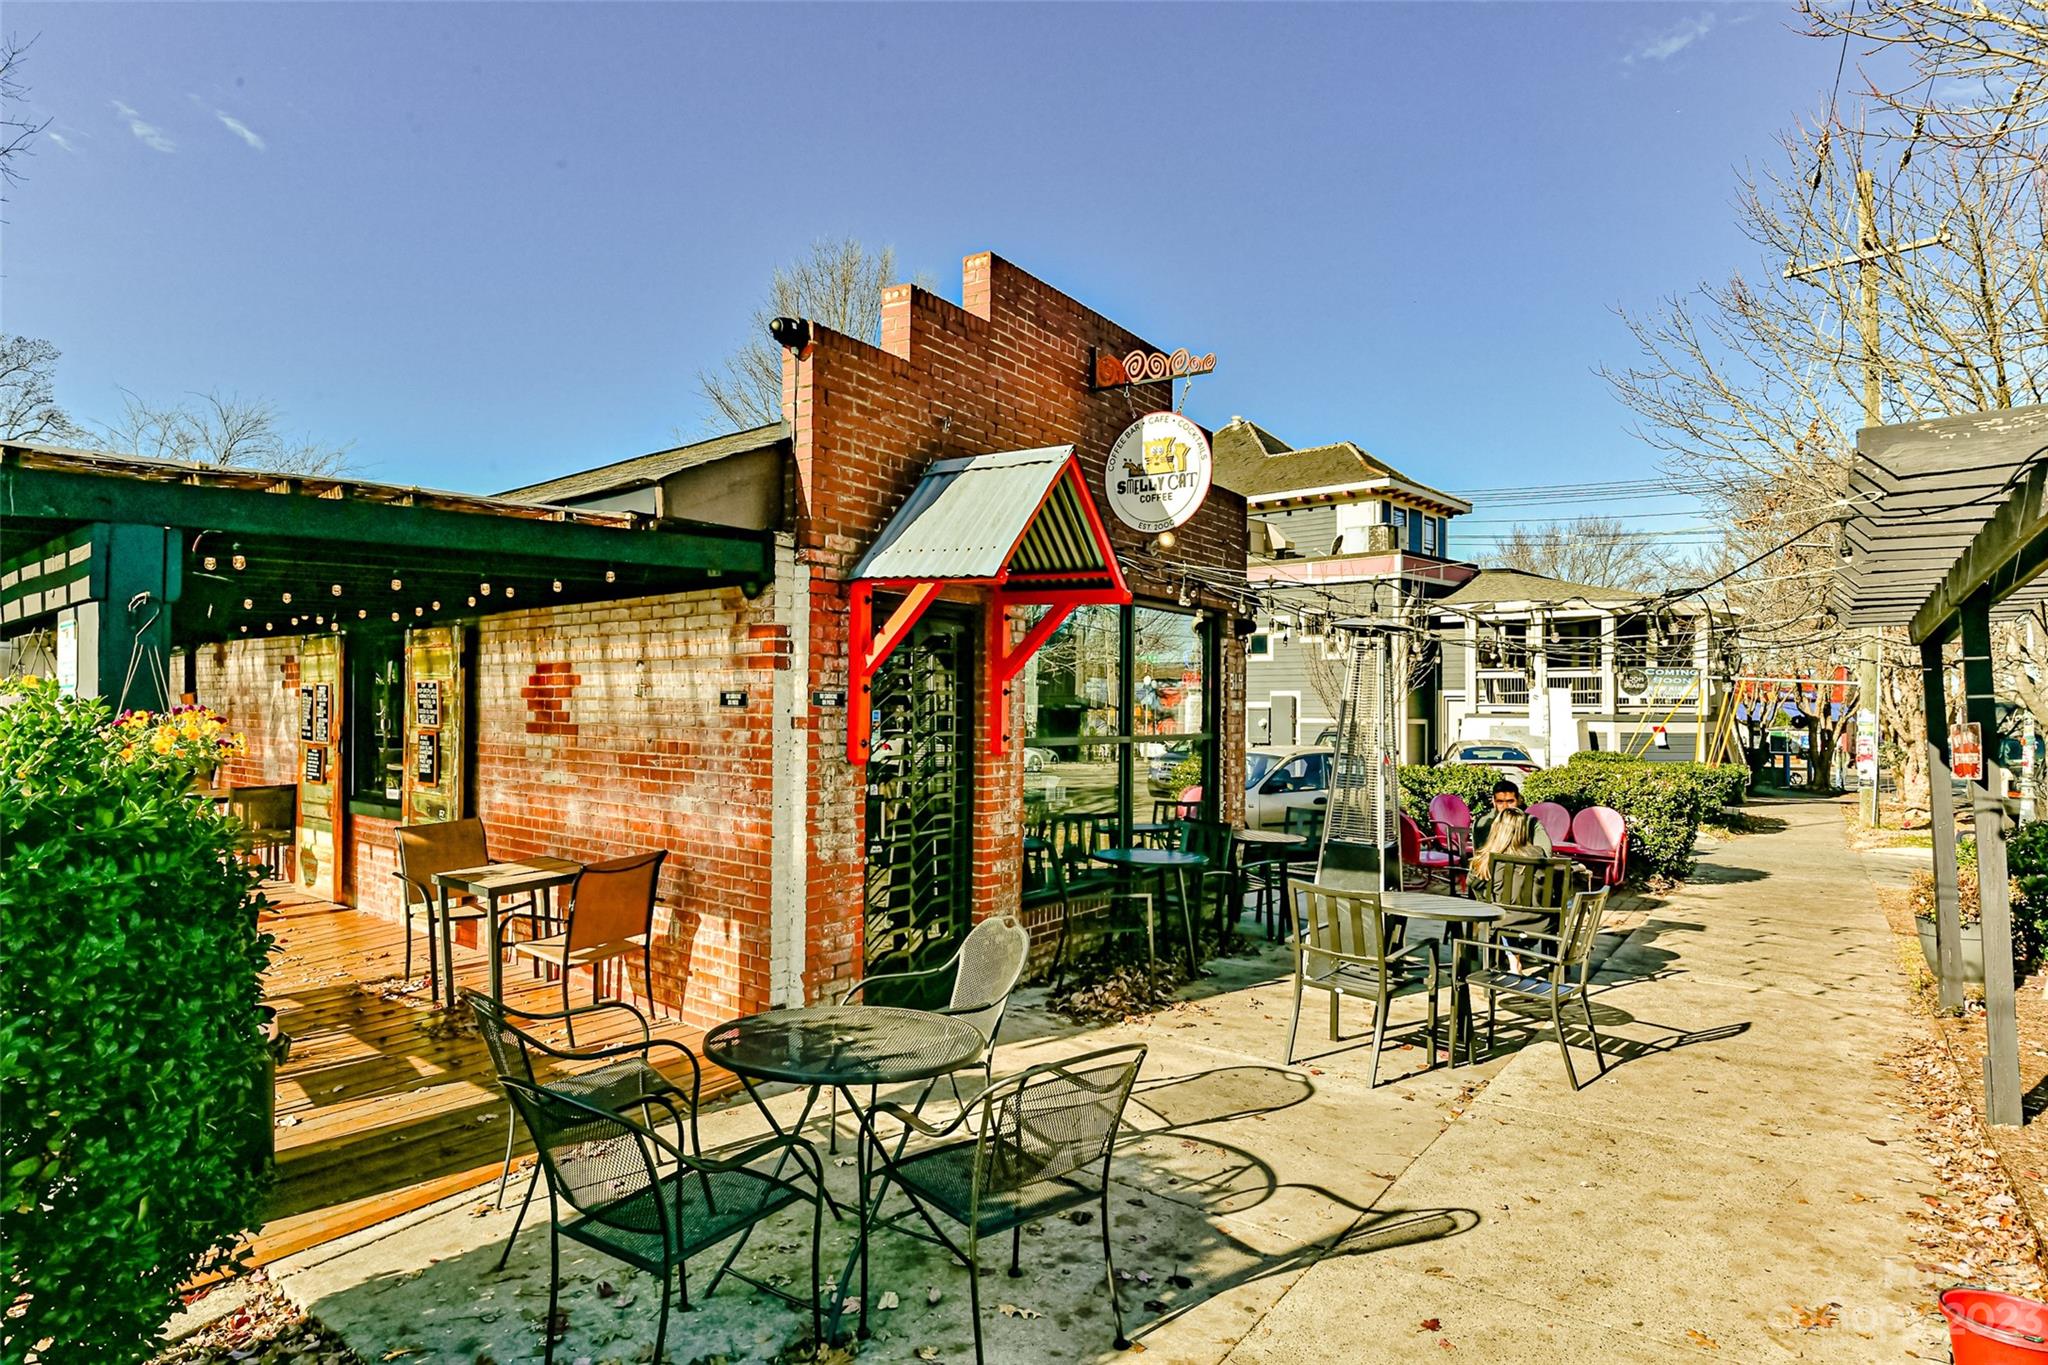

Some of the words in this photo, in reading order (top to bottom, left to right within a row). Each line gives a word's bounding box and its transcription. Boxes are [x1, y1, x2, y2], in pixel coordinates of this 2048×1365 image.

[1108, 437, 1126, 472] COFFEE
[1125, 423, 1141, 439] BAR
[1148, 415, 1170, 425] CAFE
[1177, 419, 1208, 461] COCKTAILS
[1117, 476, 1164, 495] SMELLY
[1167, 472, 1198, 490] CAT
[1139, 492, 1173, 503] COFFEE
[1645, 668, 1698, 676] COMING
